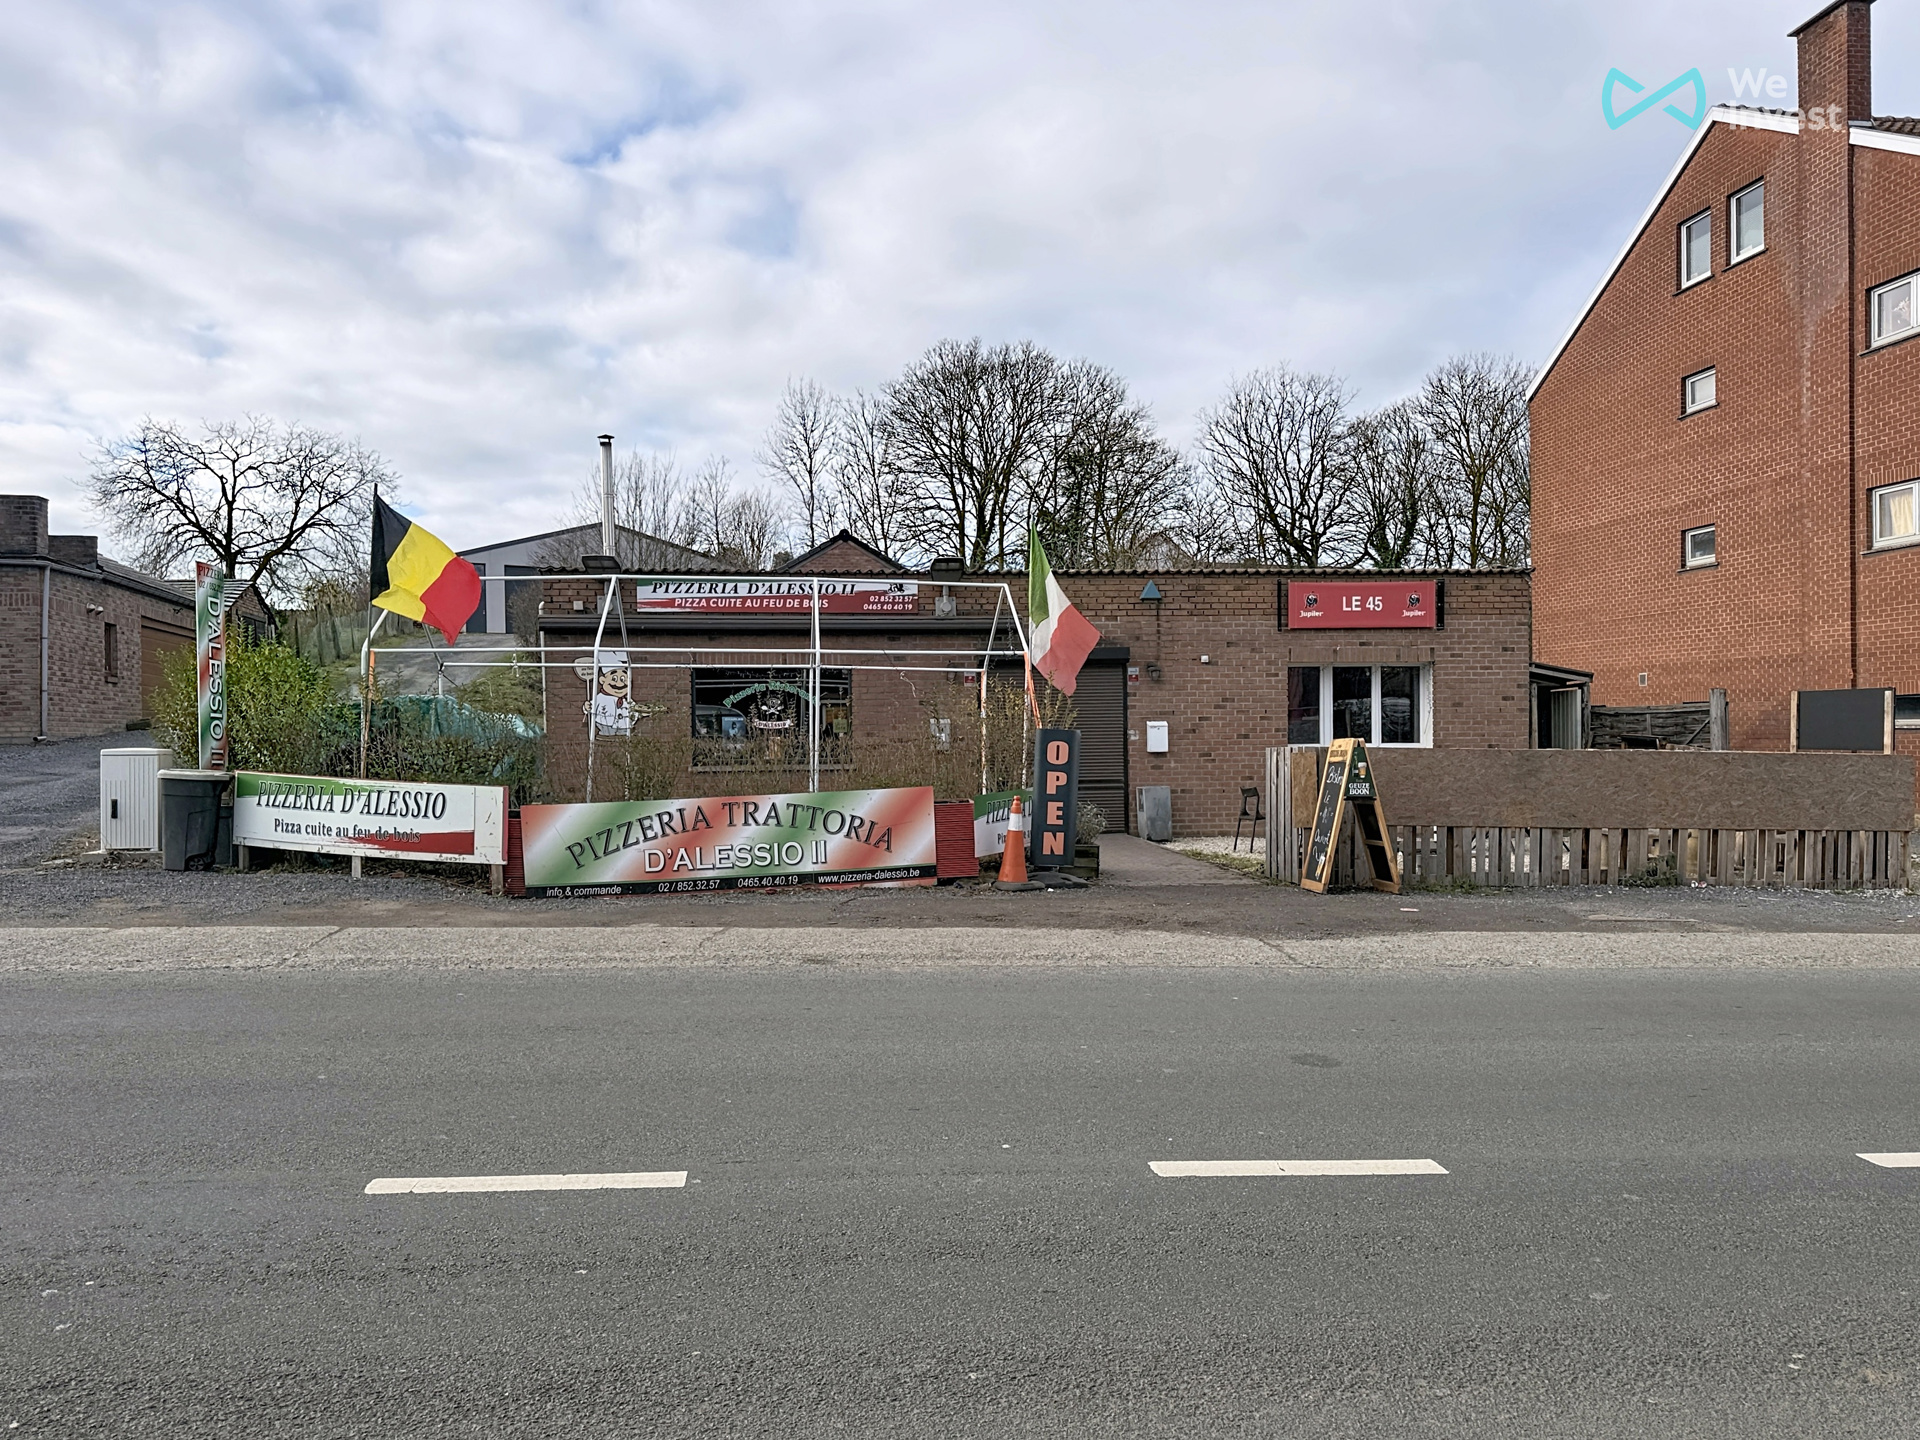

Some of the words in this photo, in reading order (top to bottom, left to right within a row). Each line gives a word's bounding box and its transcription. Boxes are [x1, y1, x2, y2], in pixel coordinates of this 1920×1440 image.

[651, 581, 740, 594] PIZZERIA
[839, 584, 857, 597] II
[674, 598, 707, 608] PIZZA
[709, 599, 743, 608] CUITE
[745, 599, 761, 608] AU
[763, 599, 784, 608] FEU
[786, 599, 801, 608] DE
[1342, 596, 1362, 612] LE
[1366, 596, 1383, 612] 45
[1299, 609, 1324, 618] Jupiler
[1401, 609, 1426, 618] Jupiler
[206, 596, 223, 741] D'ALESSIO
[768, 680, 819, 707] Ristorant
[211, 748, 225, 768] II
[256, 779, 336, 813] PIZZERIA
[340, 786, 448, 820] D'ALESSIO
[1042, 740, 1069, 856] OPEN
[274, 818, 302, 835] Pizza
[304, 821, 333, 837] cuite
[335, 827, 350, 838] au
[352, 824, 371, 840] feu
[374, 825, 390, 841] de
[393, 827, 421, 843] bois
[564, 805, 713, 869] PIZZERIA
[720, 800, 894, 854] TRATTORIA
[643, 841, 804, 873] D'ALESSIO
[811, 840, 828, 865] II
[738, 875, 799, 888] 0465.40.40.19
[817, 867, 921, 885] www.pizzeria-dalessio.be
[546, 886, 563, 897] info
[564, 887, 572, 896] &
[573, 884, 623, 897] commande
[658, 882, 671, 893] 02
[677, 880, 721, 892] 852.32.57
